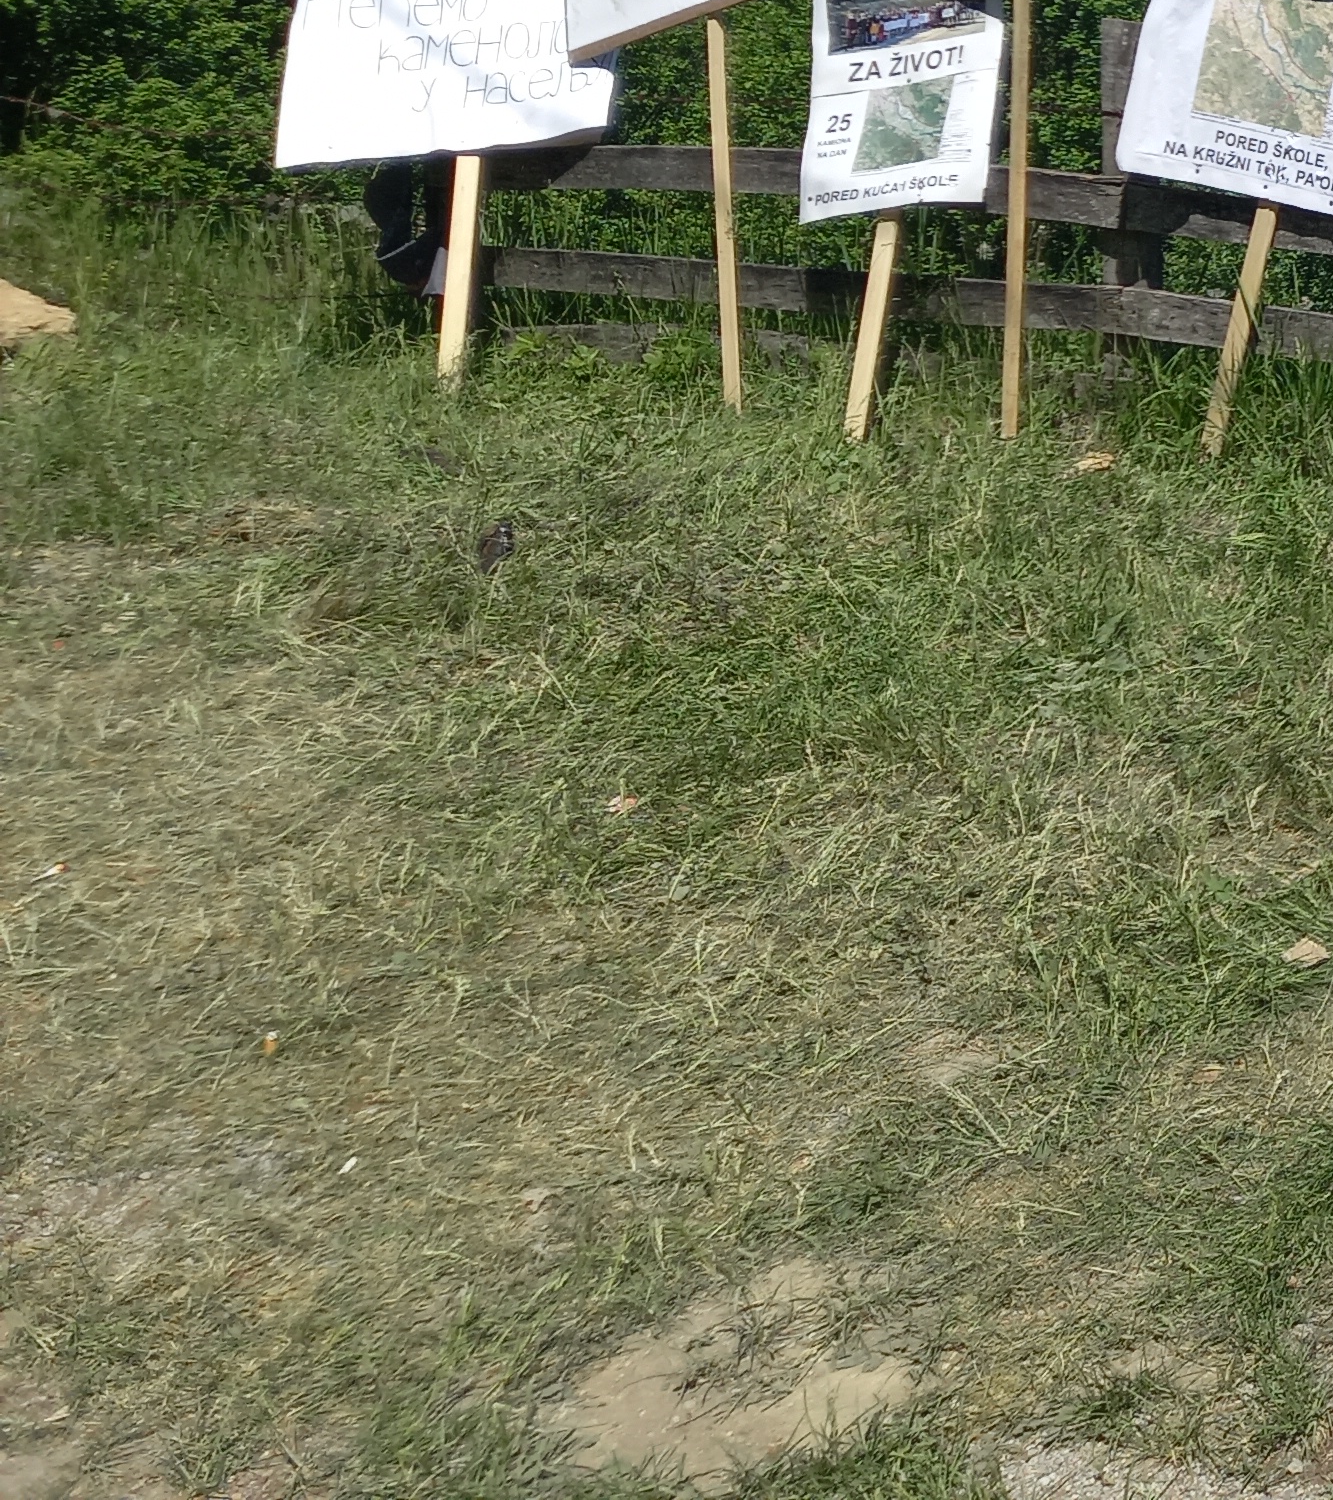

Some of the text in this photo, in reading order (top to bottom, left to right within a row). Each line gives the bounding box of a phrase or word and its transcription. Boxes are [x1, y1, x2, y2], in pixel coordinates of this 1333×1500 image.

[378, 18, 568, 75] каменоло
[848, 45, 964, 82] ZA ŽIVOT!
[826, 113, 852, 133] 25
[1163, 140, 1188, 158] NA
[1192, 145, 1251, 172] KRUŽNI
[1294, 170, 1316, 187] PA
[1215, 130, 1329, 171] PORED ŠKOLE,
[815, 188, 859, 206] PORED
